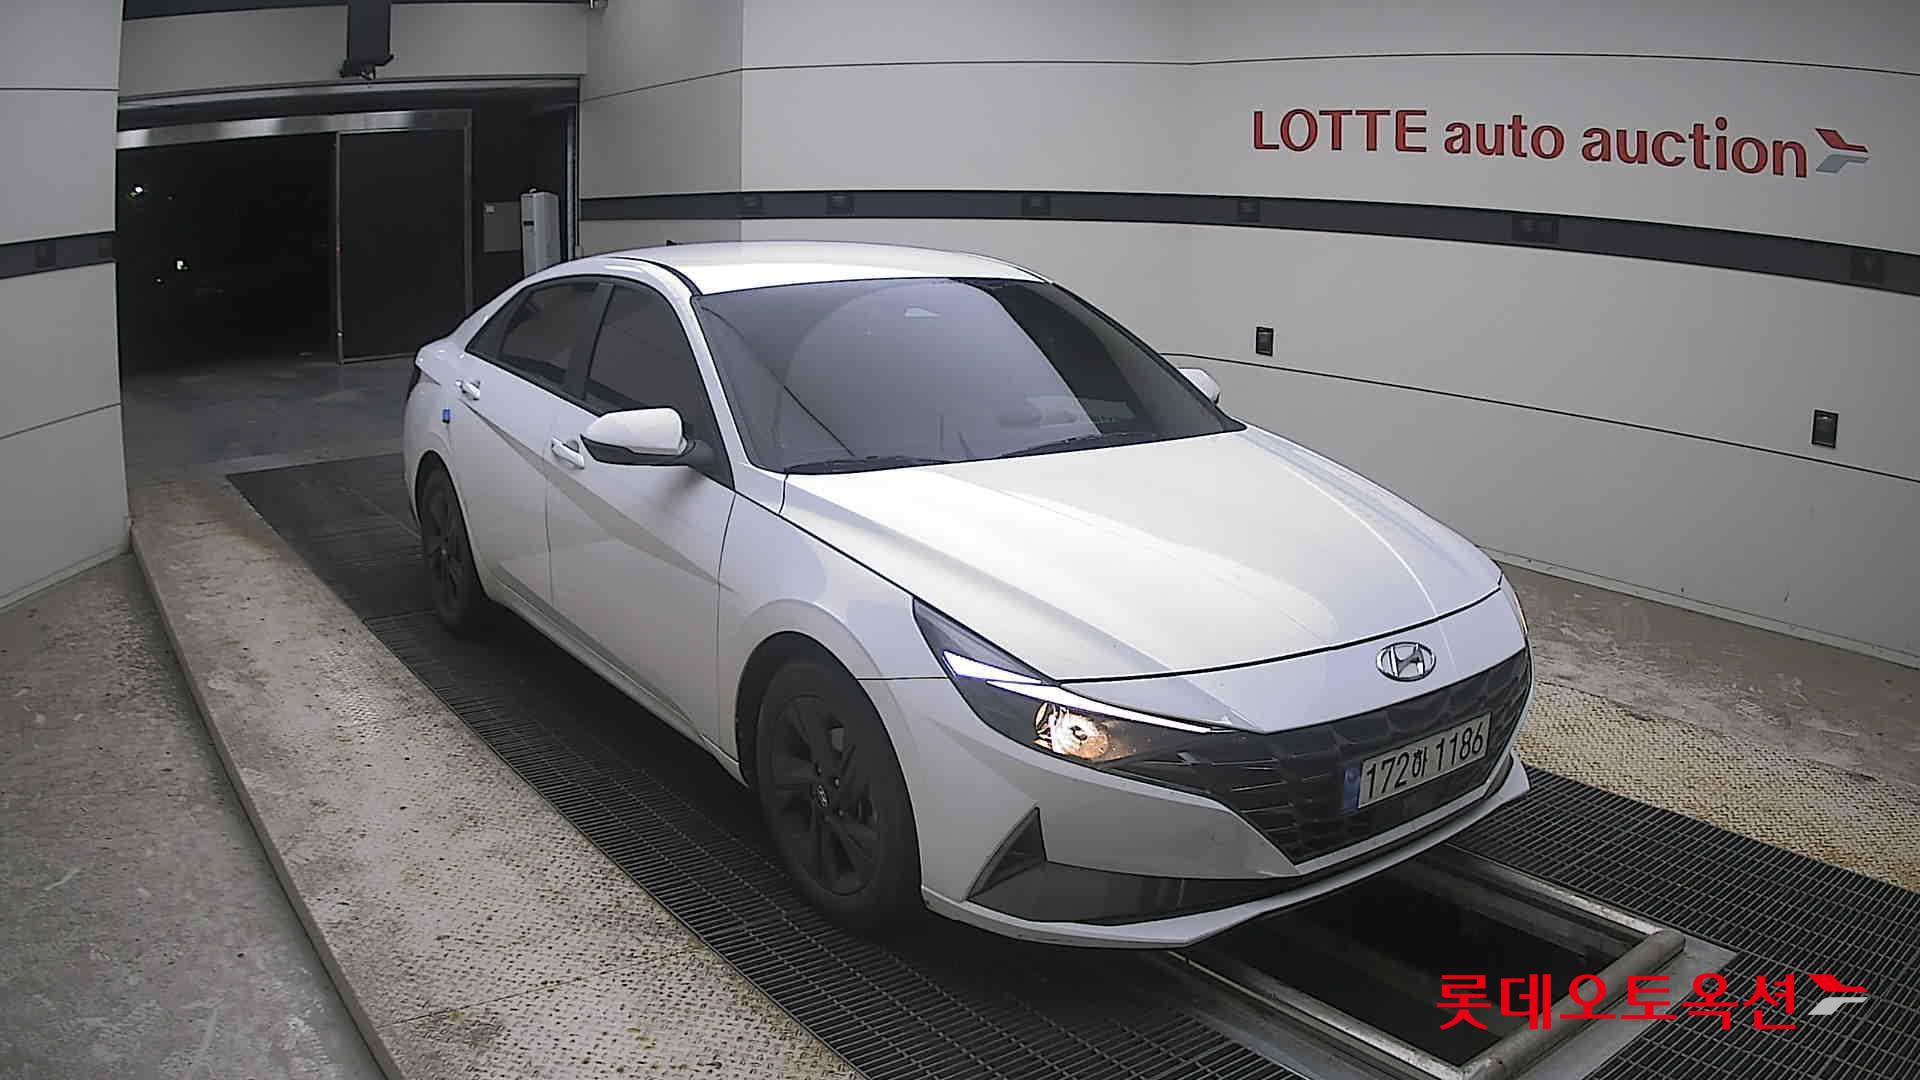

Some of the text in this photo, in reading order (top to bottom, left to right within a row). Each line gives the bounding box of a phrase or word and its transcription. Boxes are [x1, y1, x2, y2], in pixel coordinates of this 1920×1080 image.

[1253, 109, 1809, 178] LOTTE auto auction
[1366, 721, 1484, 799] 172하 1186
